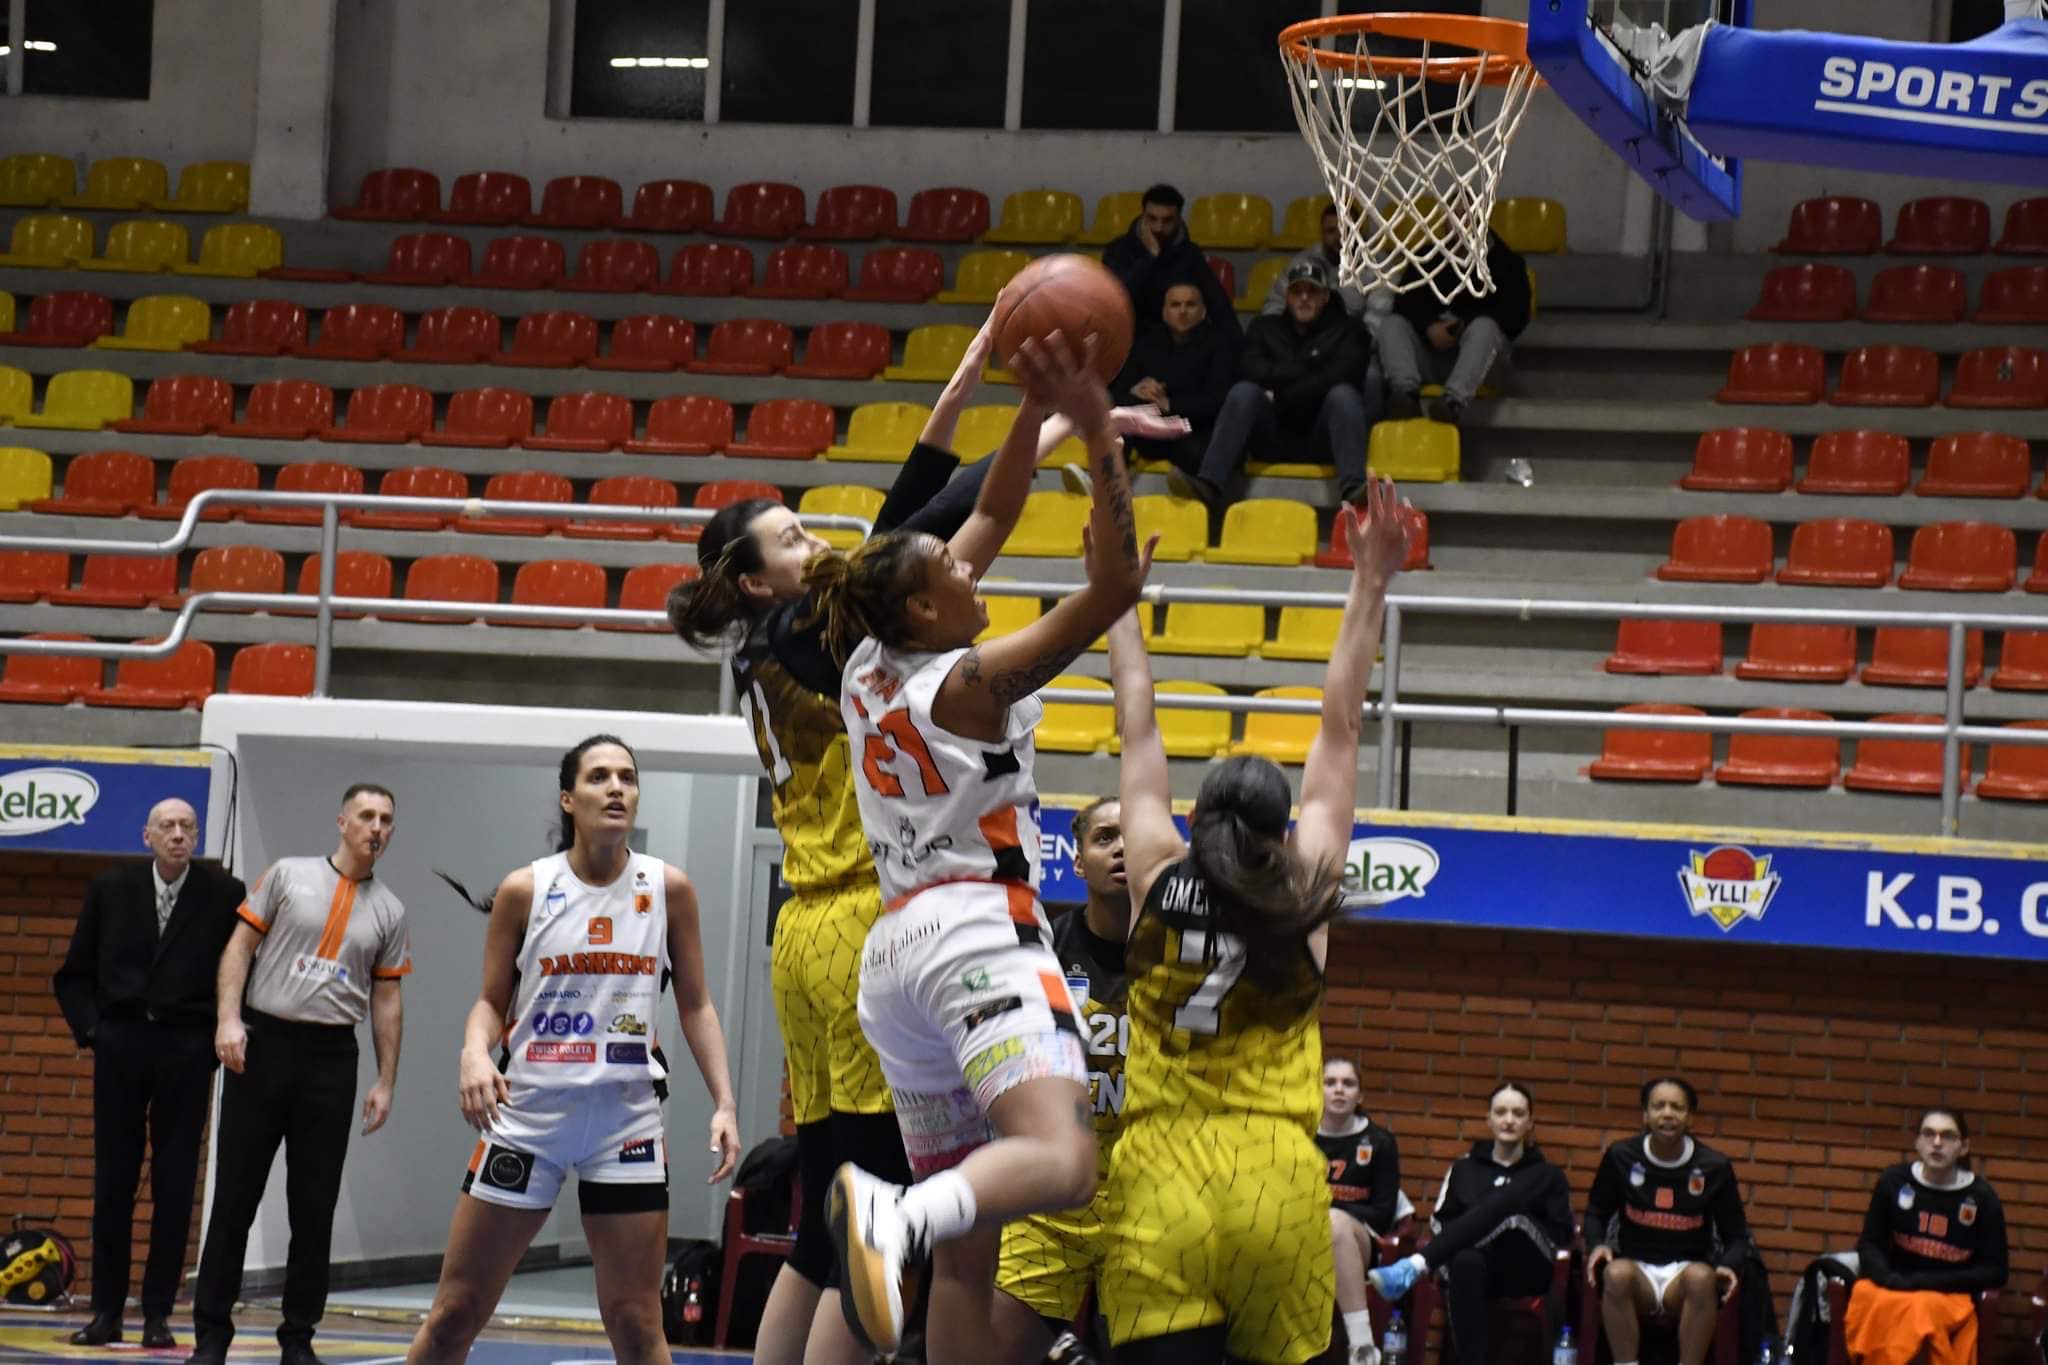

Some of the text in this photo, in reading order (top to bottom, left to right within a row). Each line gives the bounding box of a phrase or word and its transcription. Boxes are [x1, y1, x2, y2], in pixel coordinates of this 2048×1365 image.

[0, 781, 83, 823] elax
[1341, 849, 1421, 892] elax
[1708, 882, 1748, 904] YLLI
[1865, 870, 2000, 936] K.B.
[587, 916, 613, 945] 9
[1174, 929, 1248, 1036] 7
